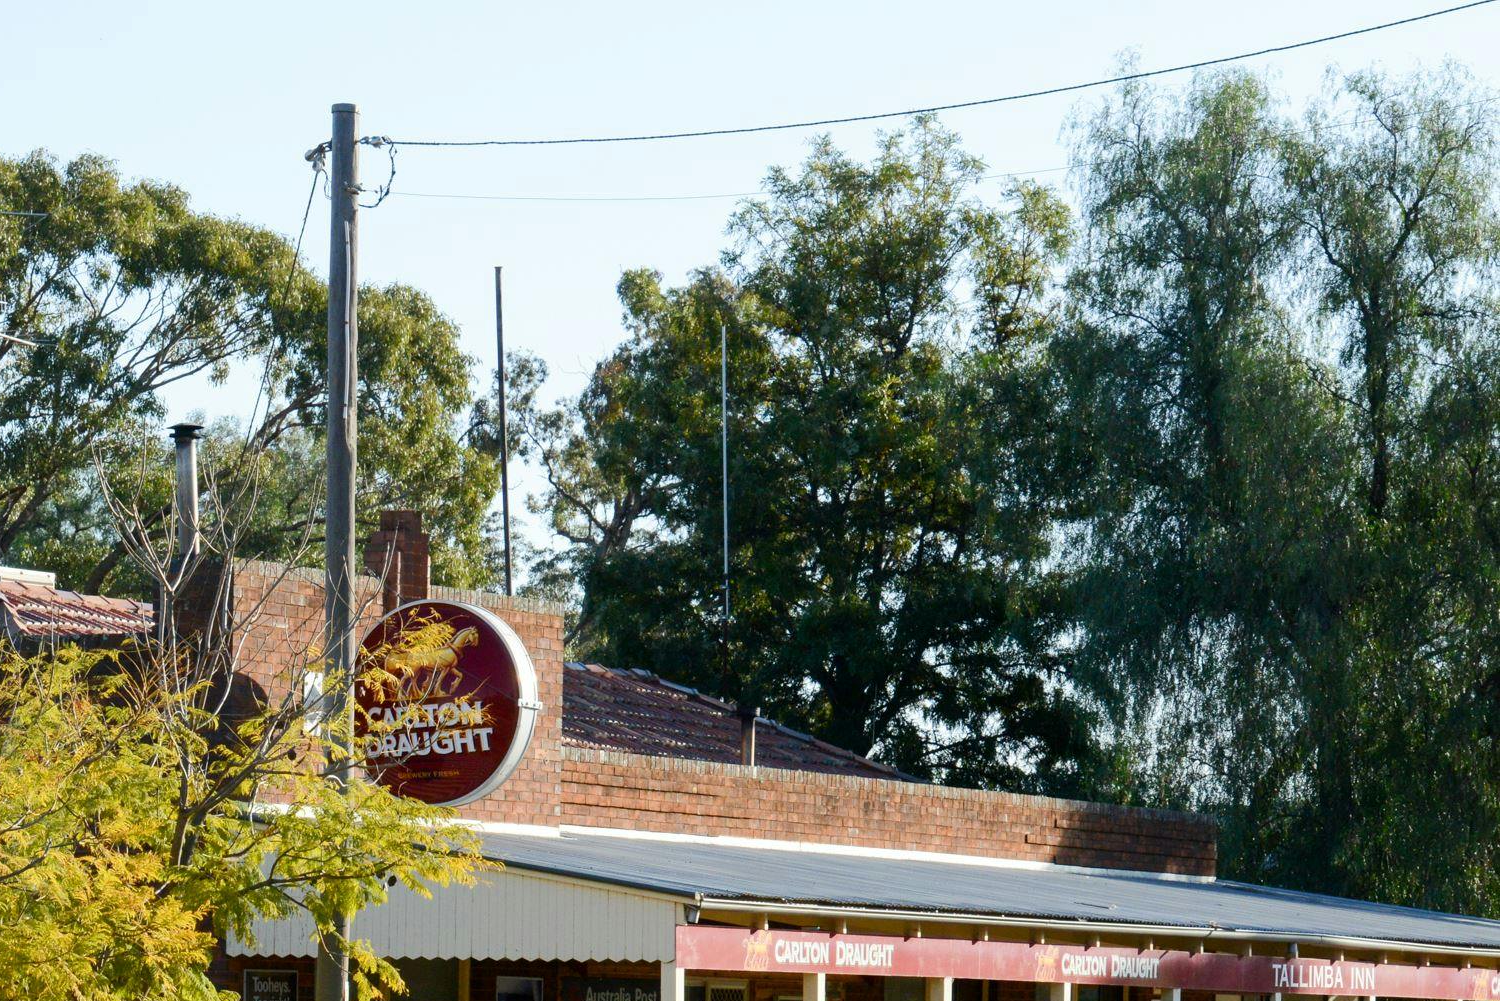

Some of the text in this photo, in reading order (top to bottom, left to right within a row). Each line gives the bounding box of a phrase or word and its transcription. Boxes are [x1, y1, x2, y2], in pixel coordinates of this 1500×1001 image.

[368, 700, 483, 731] CARLTON
[364, 727, 494, 758] DRAUGHT
[775, 939, 894, 966] CARLTON DRAUGHT
[1061, 953, 1160, 979] CARLTON DRAUGHT
[1272, 963, 1375, 990] TALLIMBA INN
